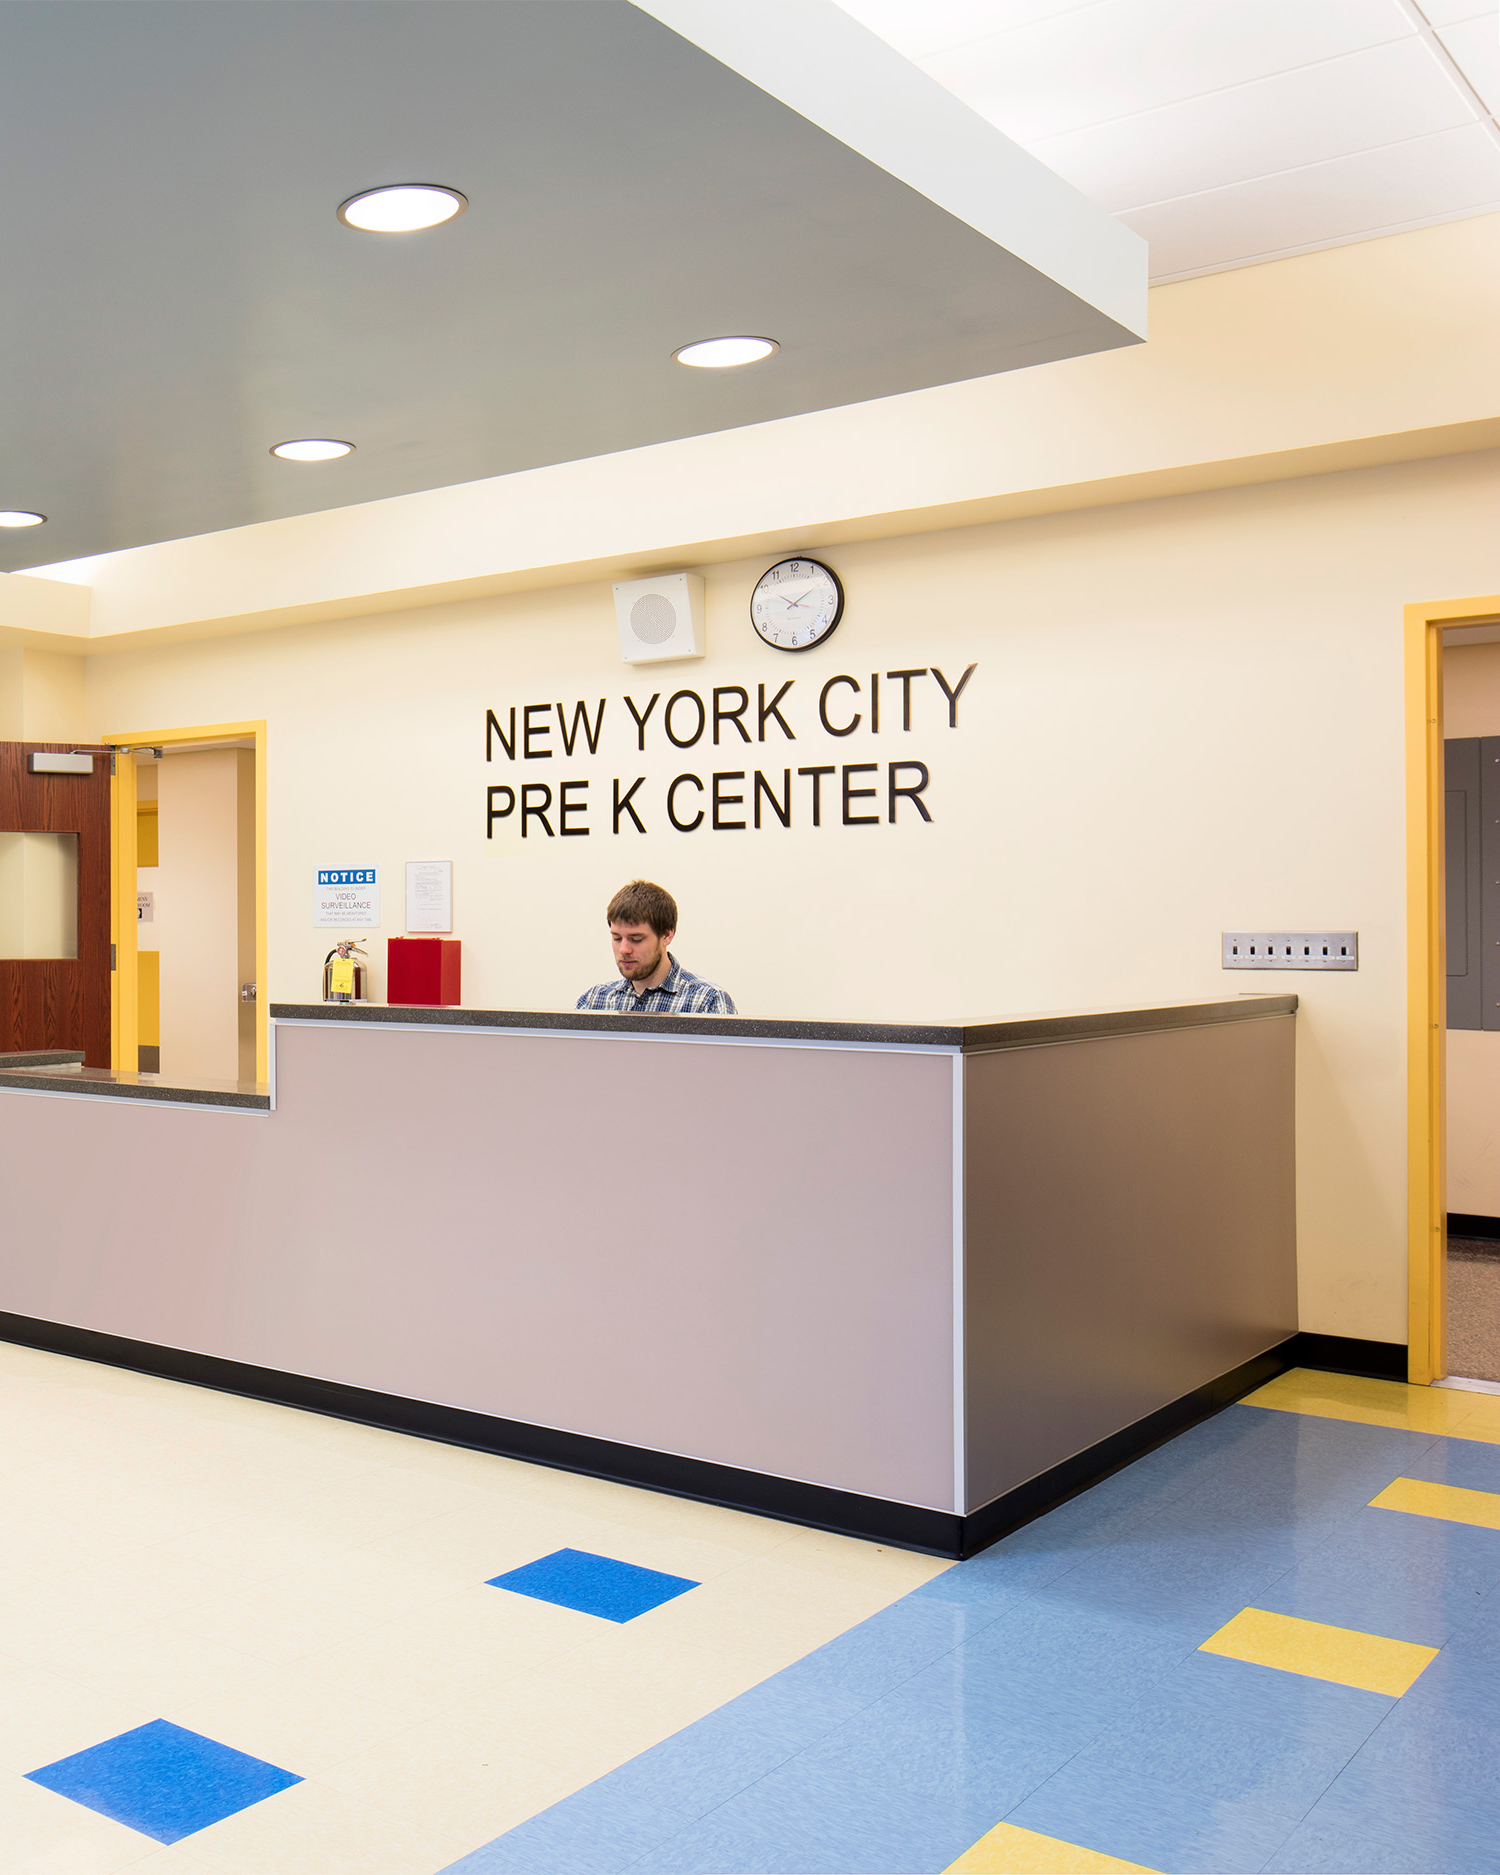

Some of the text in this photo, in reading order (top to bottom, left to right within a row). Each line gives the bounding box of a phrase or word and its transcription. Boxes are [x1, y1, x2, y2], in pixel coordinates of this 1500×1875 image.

[790, 562, 799, 572] 12
[810, 565, 814, 574] 1
[772, 570, 780, 580] 11
[760, 584, 769, 594] 10
[828, 595, 834, 605] 3
[756, 604, 762, 614] 9
[821, 614, 828, 624] 4
[762, 622, 768, 632] 8
[773, 633, 779, 643] 7
[809, 629, 816, 639] 5
[791, 636, 798, 646] 6
[485, 661, 979, 763] NEW YORK CITY
[486, 760, 936, 839] PRE K CENTER
[320, 871, 374, 883] NOTICE
[335, 892, 357, 900] VIDEO
[320, 901, 372, 909] SURVEILLANCE
